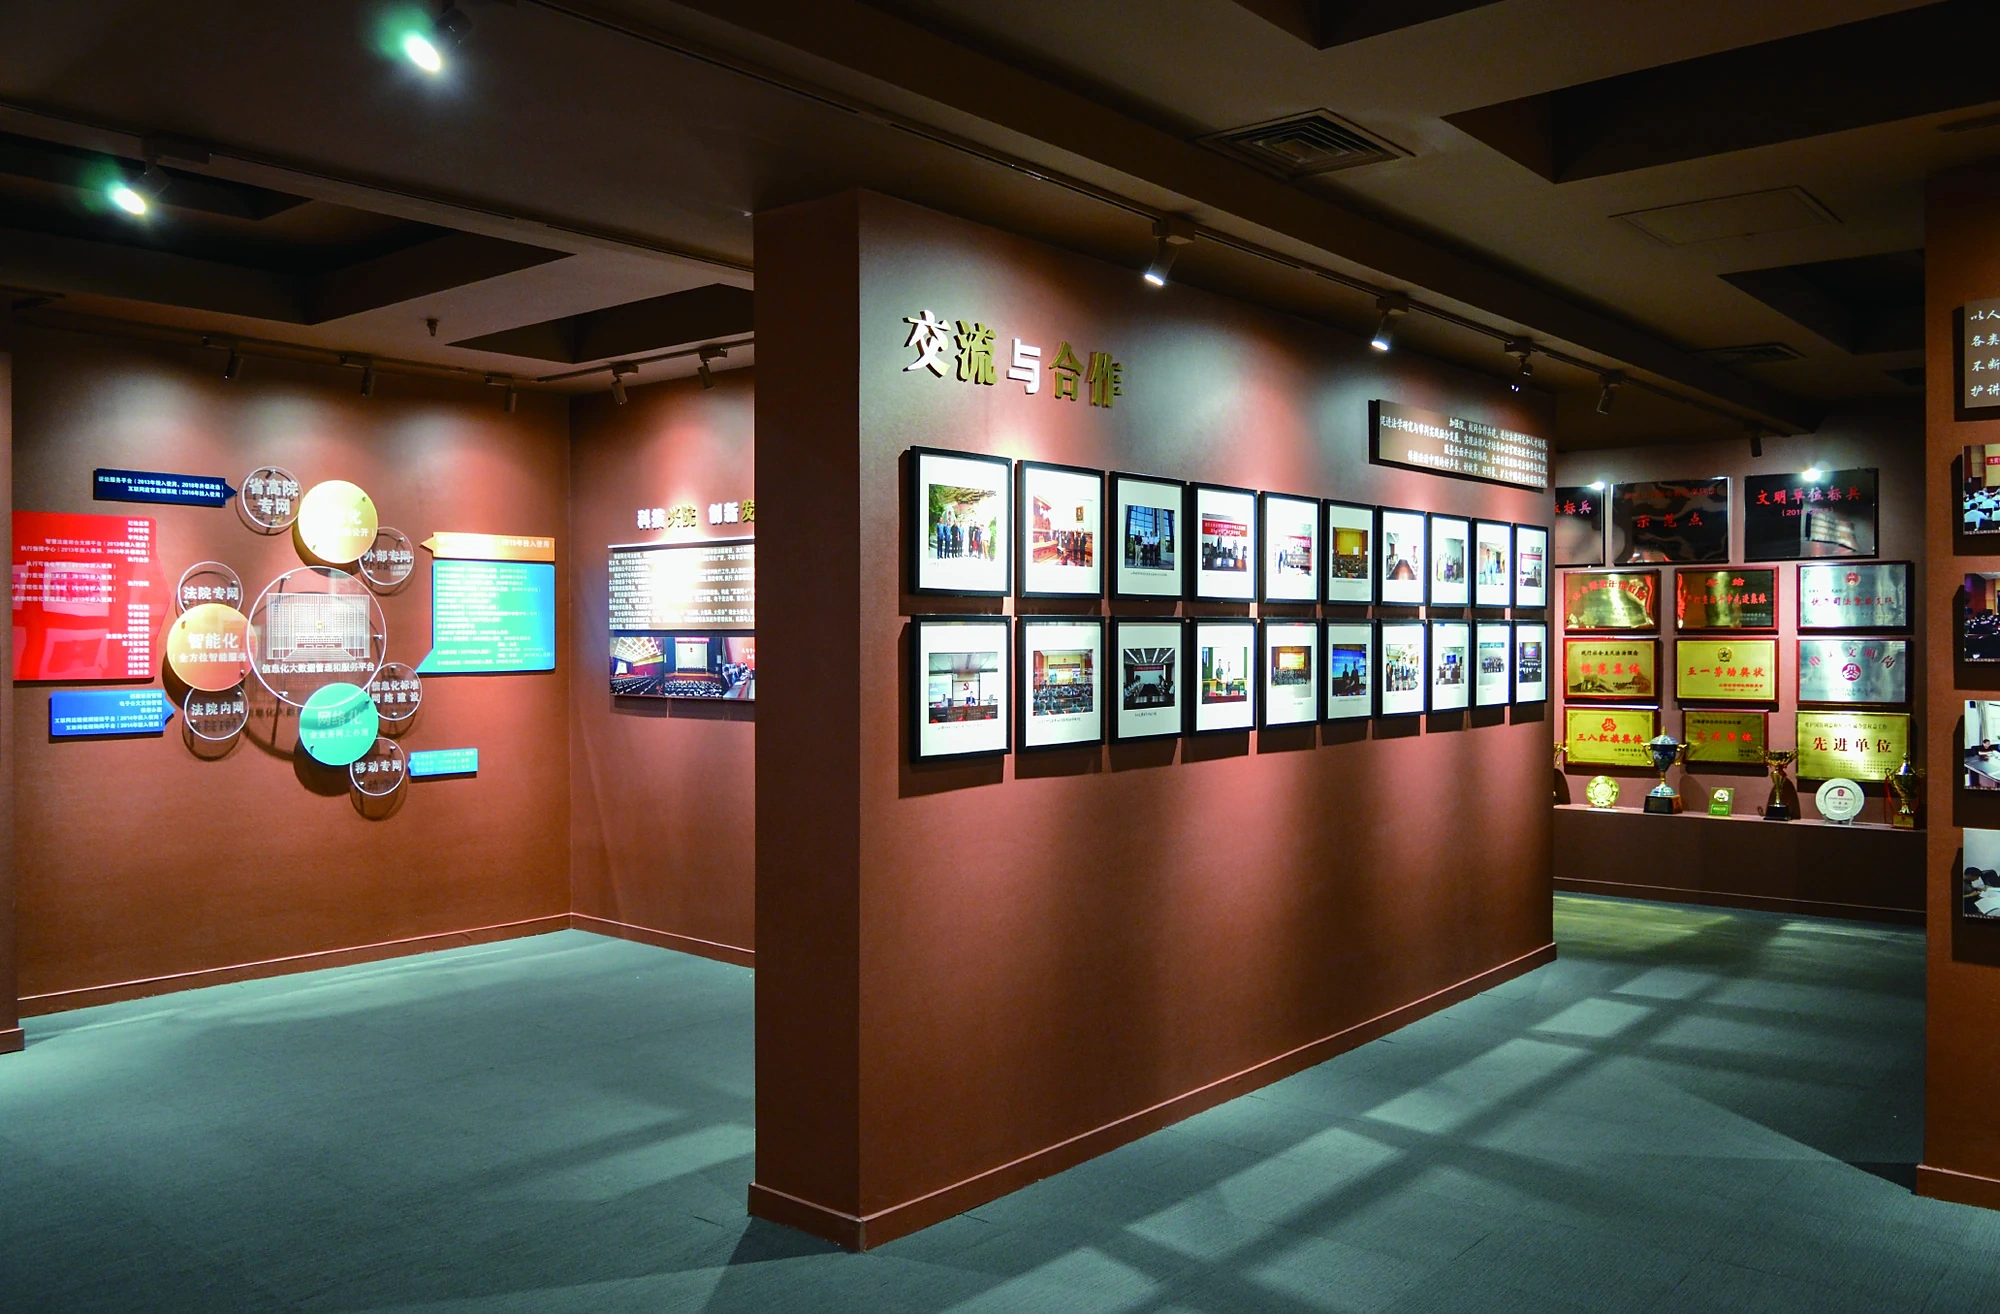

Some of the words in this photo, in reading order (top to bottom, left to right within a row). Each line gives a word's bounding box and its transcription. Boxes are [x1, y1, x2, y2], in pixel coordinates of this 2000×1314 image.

[1970, 309, 2000, 321] 以人
[1971, 333, 2000, 347] 各类
[903, 310, 1123, 408] 交流与合作
[1972, 357, 2000, 372] 不断
[249, 477, 300, 497] 省高院
[257, 496, 292, 516] 专网
[637, 504, 697, 530] 科技兴院
[1637, 512, 1703, 529] 示范点
[364, 549, 411, 563] 外部专网
[184, 586, 239, 602] 法院专网
[188, 633, 239, 651] 智能化
[1809, 646, 1896, 669] 巾文明岗
[1580, 662, 1642, 676] 模范集体
[1687, 666, 1765, 678] 五一劳动奖状
[371, 680, 420, 691] 信息化标准
[191, 701, 244, 716] 法院内网
[317, 709, 362, 726] 网络化
[1576, 733, 1644, 744] 三八红旗集体
[1813, 737, 1891, 753] 先进单位
[355, 761, 403, 773] 移动专网
